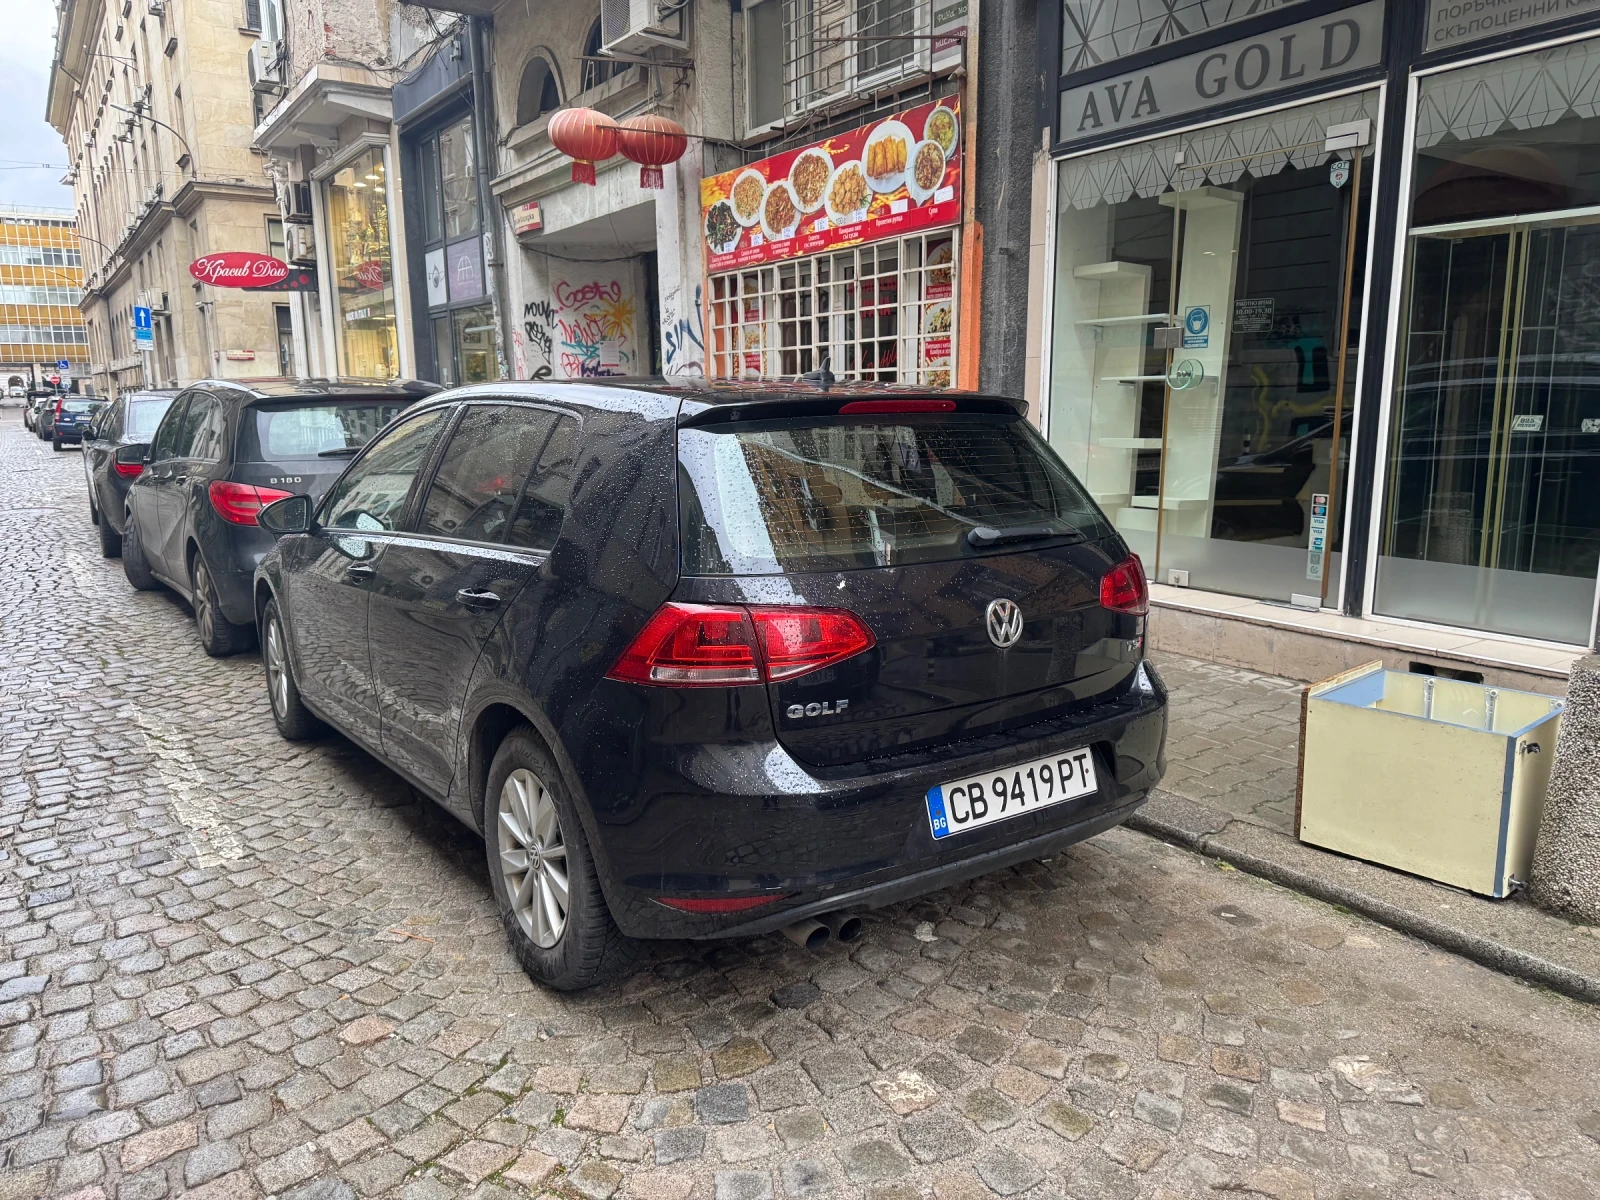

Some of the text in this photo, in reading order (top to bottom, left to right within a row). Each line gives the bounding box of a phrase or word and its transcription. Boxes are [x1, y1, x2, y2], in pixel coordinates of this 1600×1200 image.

[1434, 0, 1559, 42] СКЪПОЦЕННИ
[1077, 18, 1362, 133] AVA GOLD
[195, 258, 287, 283] Красив Дом
[786, 698, 849, 719] GOLF
[933, 817, 947, 831] BG
